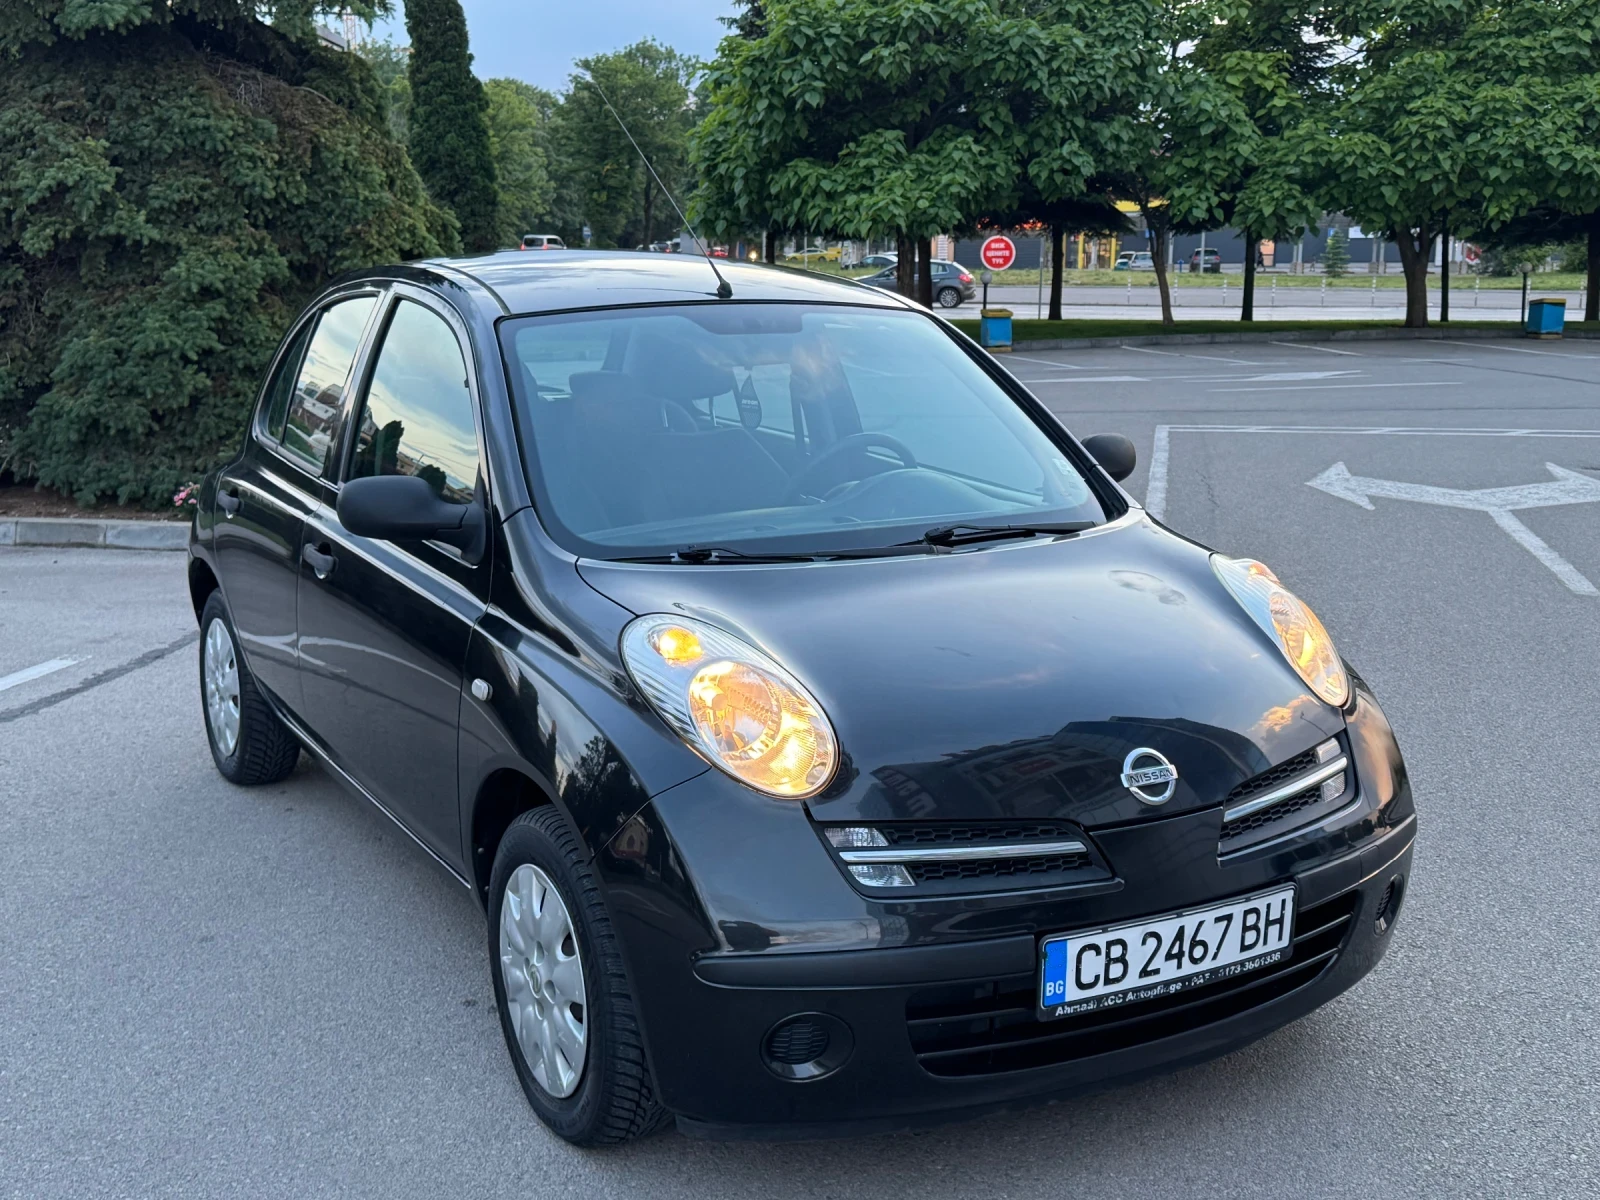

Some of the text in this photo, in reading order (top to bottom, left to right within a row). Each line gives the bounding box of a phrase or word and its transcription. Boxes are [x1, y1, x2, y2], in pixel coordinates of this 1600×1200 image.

[1130, 769, 1174, 784] NISSAN
[1138, 913, 1234, 979] 2467
[1046, 980, 1064, 997] BG
